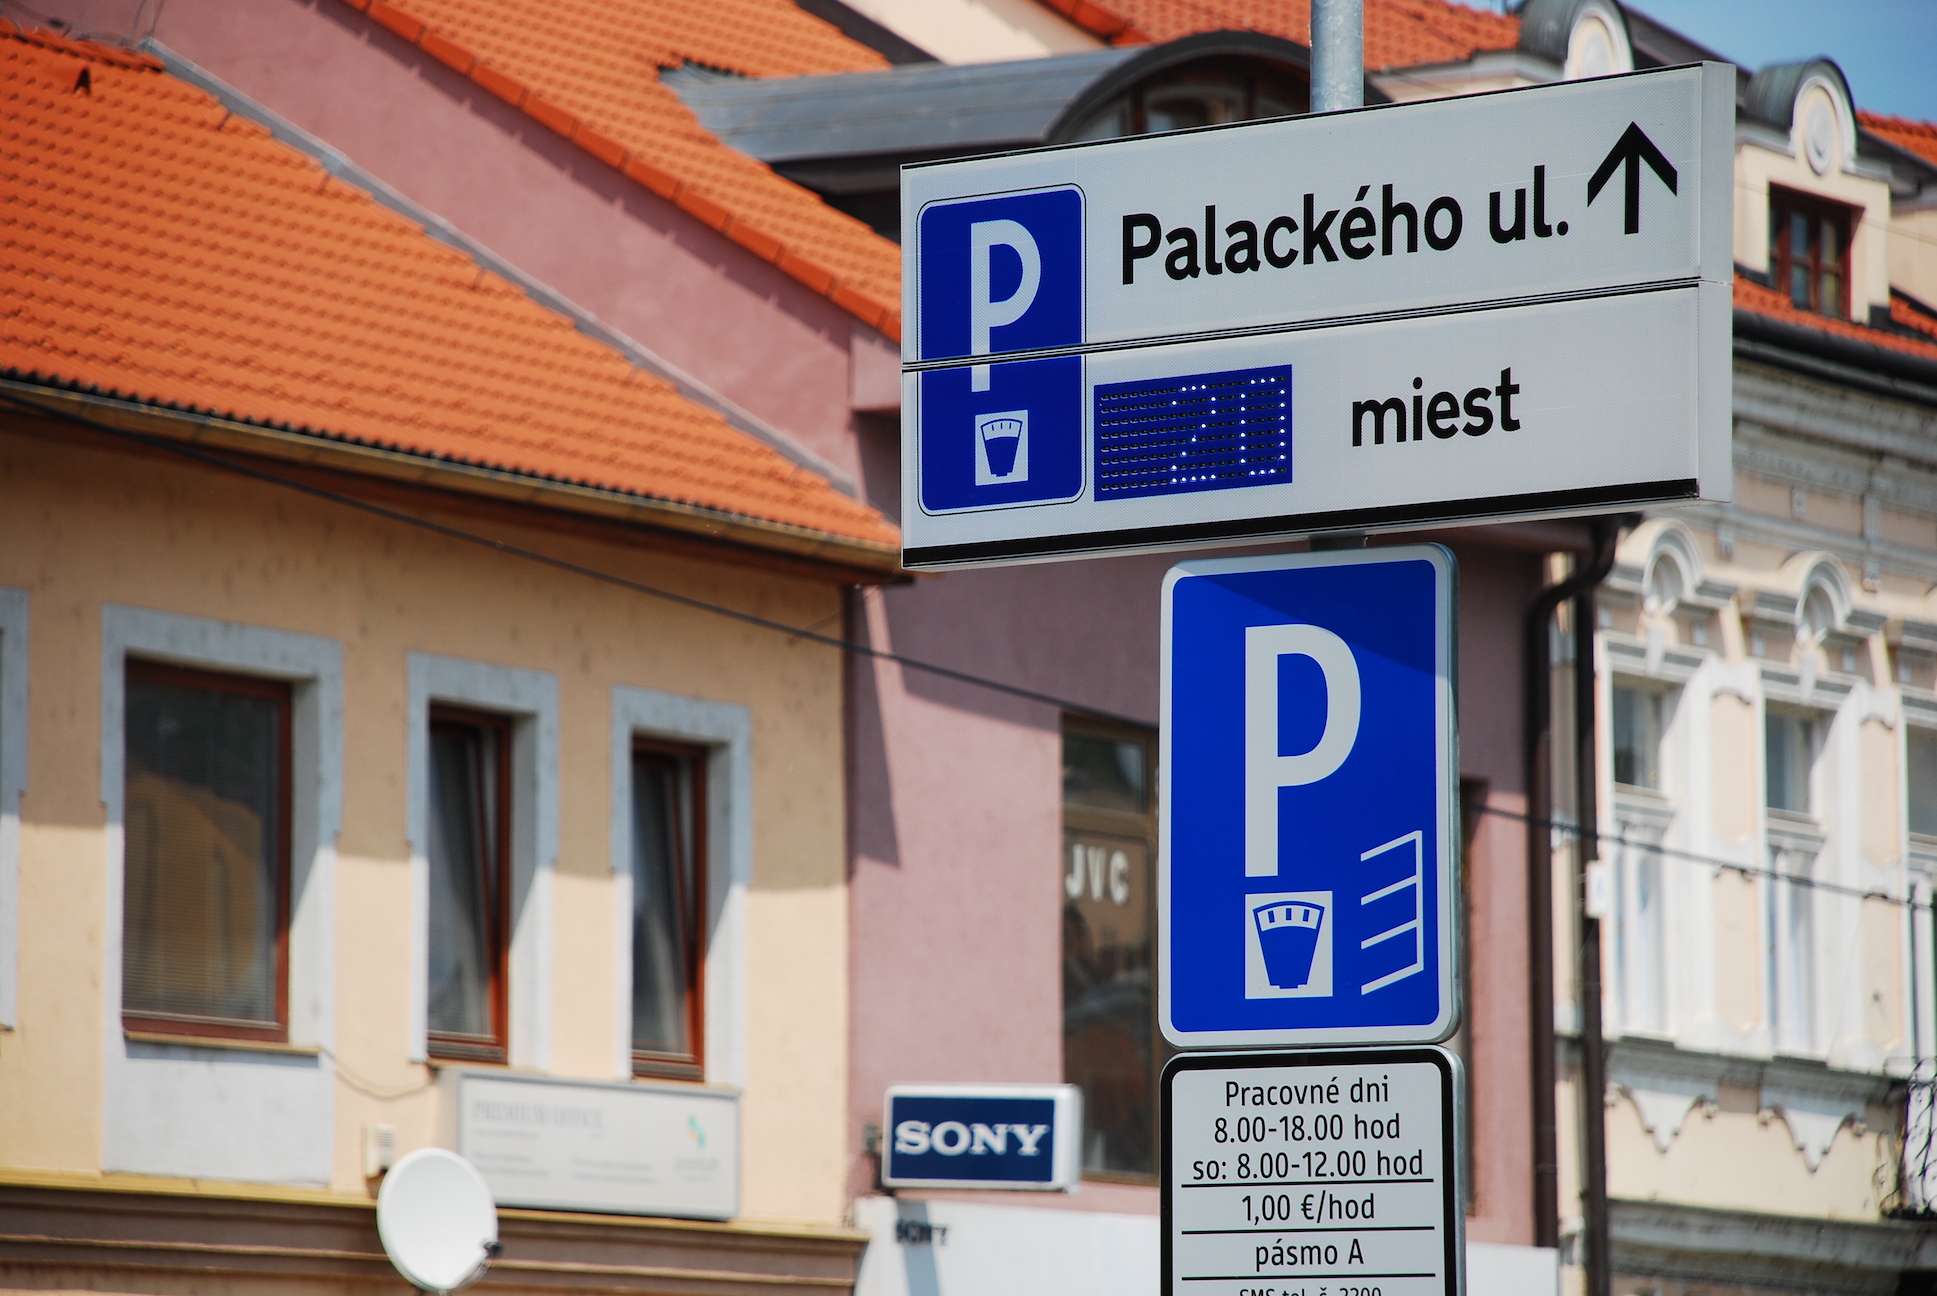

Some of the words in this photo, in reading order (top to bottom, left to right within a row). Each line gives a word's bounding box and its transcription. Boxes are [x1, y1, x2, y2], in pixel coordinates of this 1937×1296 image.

[1122, 184, 1463, 285] Palackého
[1489, 165, 1569, 244] ul.
[971, 219, 1041, 392] P
[1352, 367, 1521, 446] miest
[1245, 624, 1361, 877] P
[1064, 843, 1129, 906] JVC
[1225, 1076, 1340, 1107] Pracovné
[1350, 1074, 1389, 1104] dni
[895, 1121, 1049, 1156] SONY
[1214, 1114, 1343, 1143] 8.00-18.00
[1354, 1112, 1400, 1140] hod
[1193, 1160, 1227, 1180] so:
[1237, 1150, 1366, 1180] 8.00-12.00
[1377, 1149, 1423, 1176] hod
[1241, 1194, 1291, 1226] 1,00
[1300, 1189, 1375, 1224] €/hod
[1255, 1238, 1338, 1273] pásmo
[1347, 1238, 1364, 1265] A
